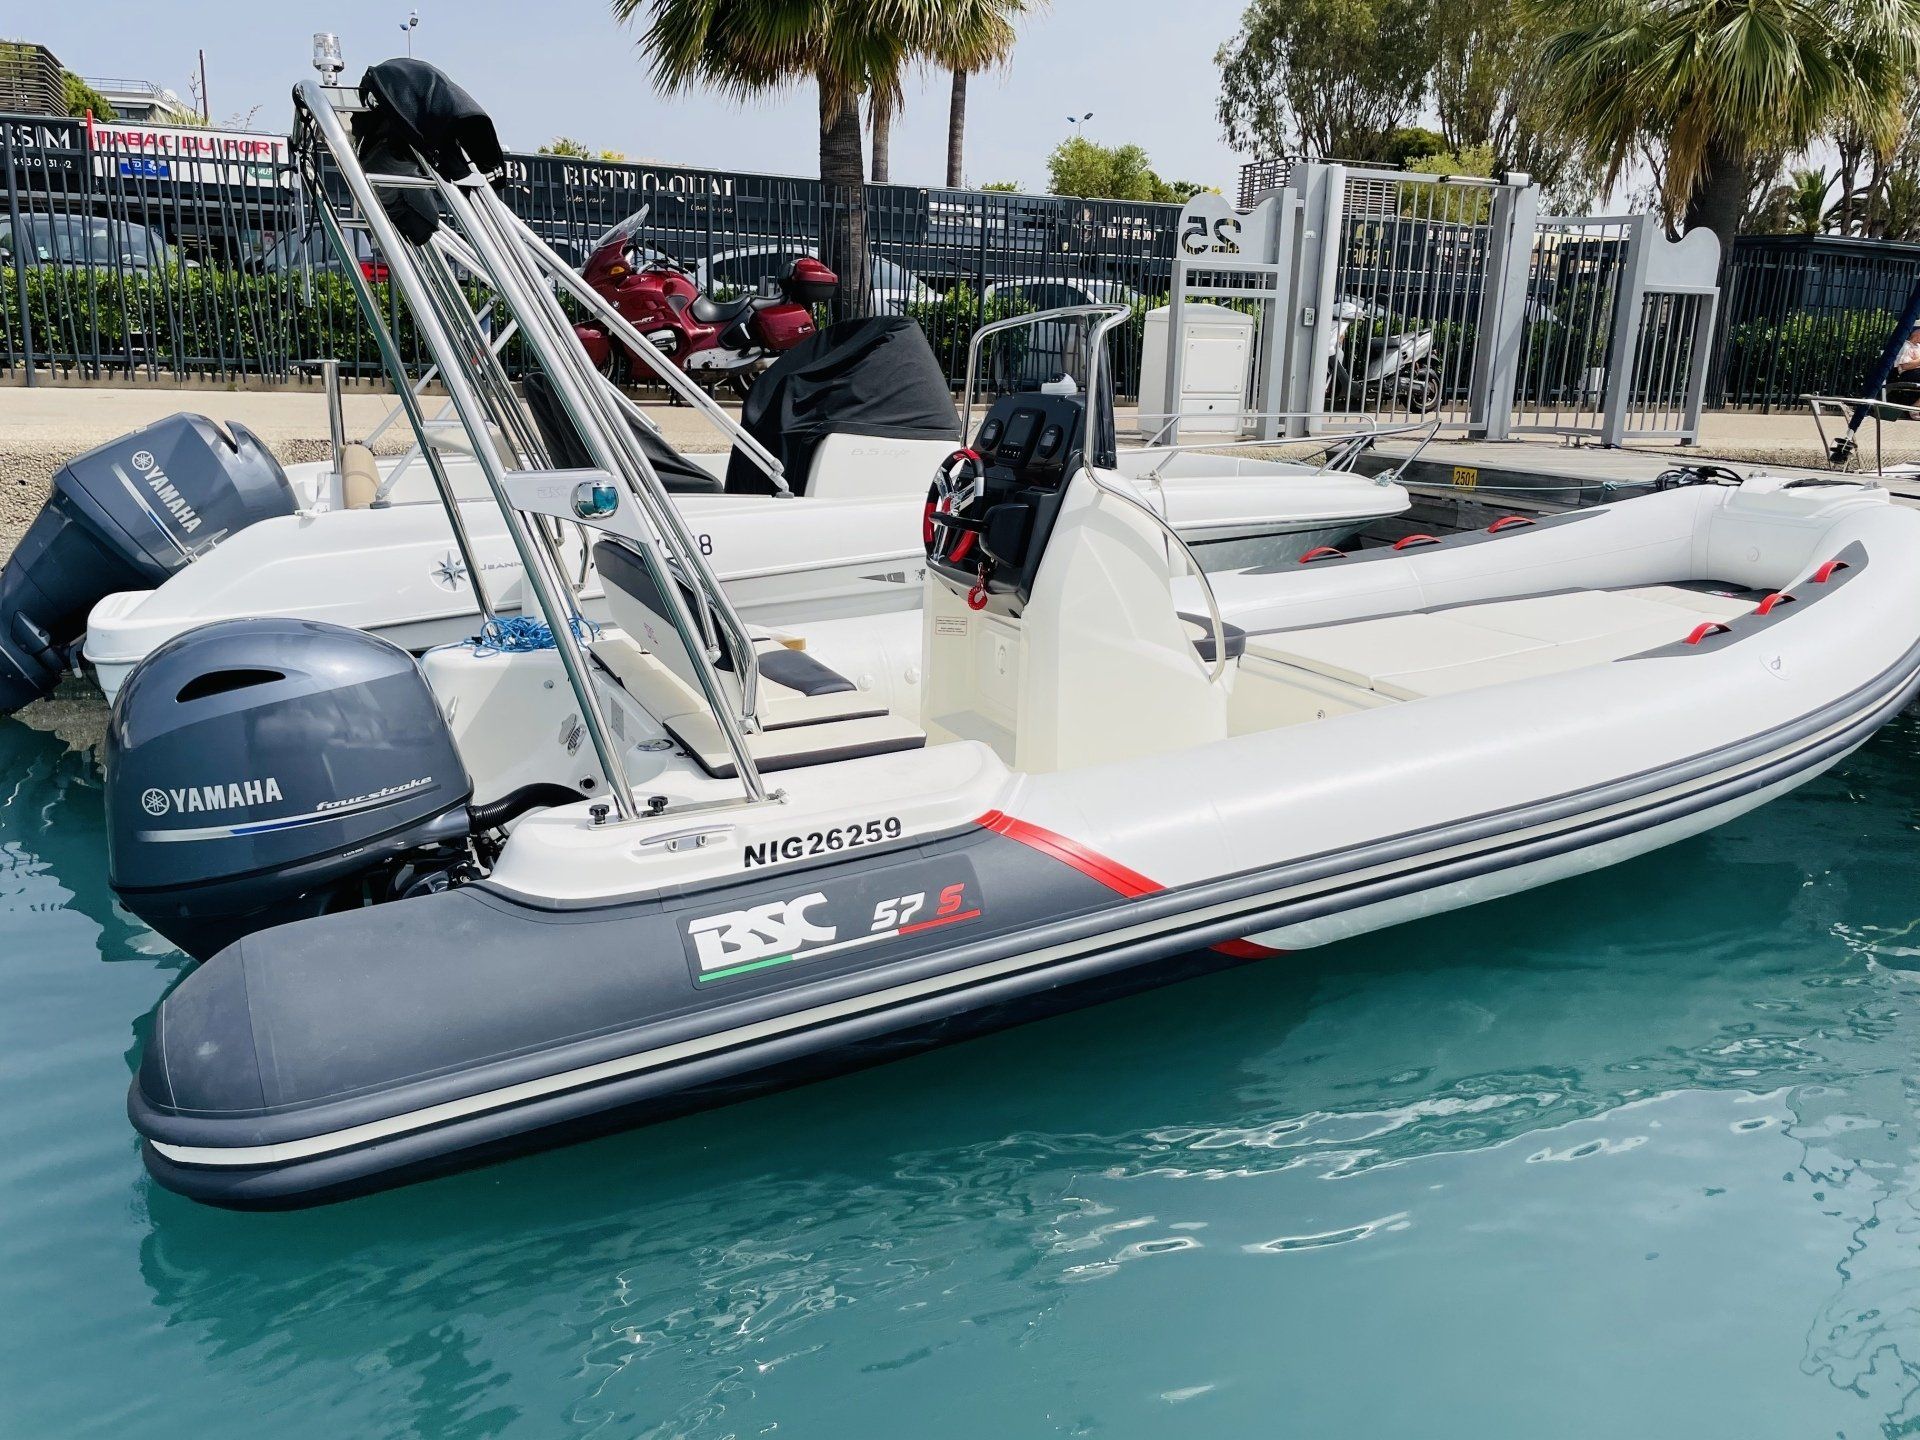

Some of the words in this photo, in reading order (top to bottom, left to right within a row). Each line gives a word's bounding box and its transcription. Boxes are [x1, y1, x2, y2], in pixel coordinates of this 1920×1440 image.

[97, 131, 173, 148] TABAC
[182, 136, 214, 151] DU
[224, 140, 283, 155] PORT
[563, 166, 734, 202] BISTRO-QUAI
[1455, 471, 1475, 486] 2501
[144, 465, 202, 534] YAMAHA
[169, 777, 284, 813] YAMAHA
[316, 795, 367, 811] four
[368, 776, 432, 798] stroke
[744, 816, 902, 868] NIG26259
[687, 891, 836, 971] BSC
[871, 892, 925, 930] 57
[936, 884, 965, 915] S
